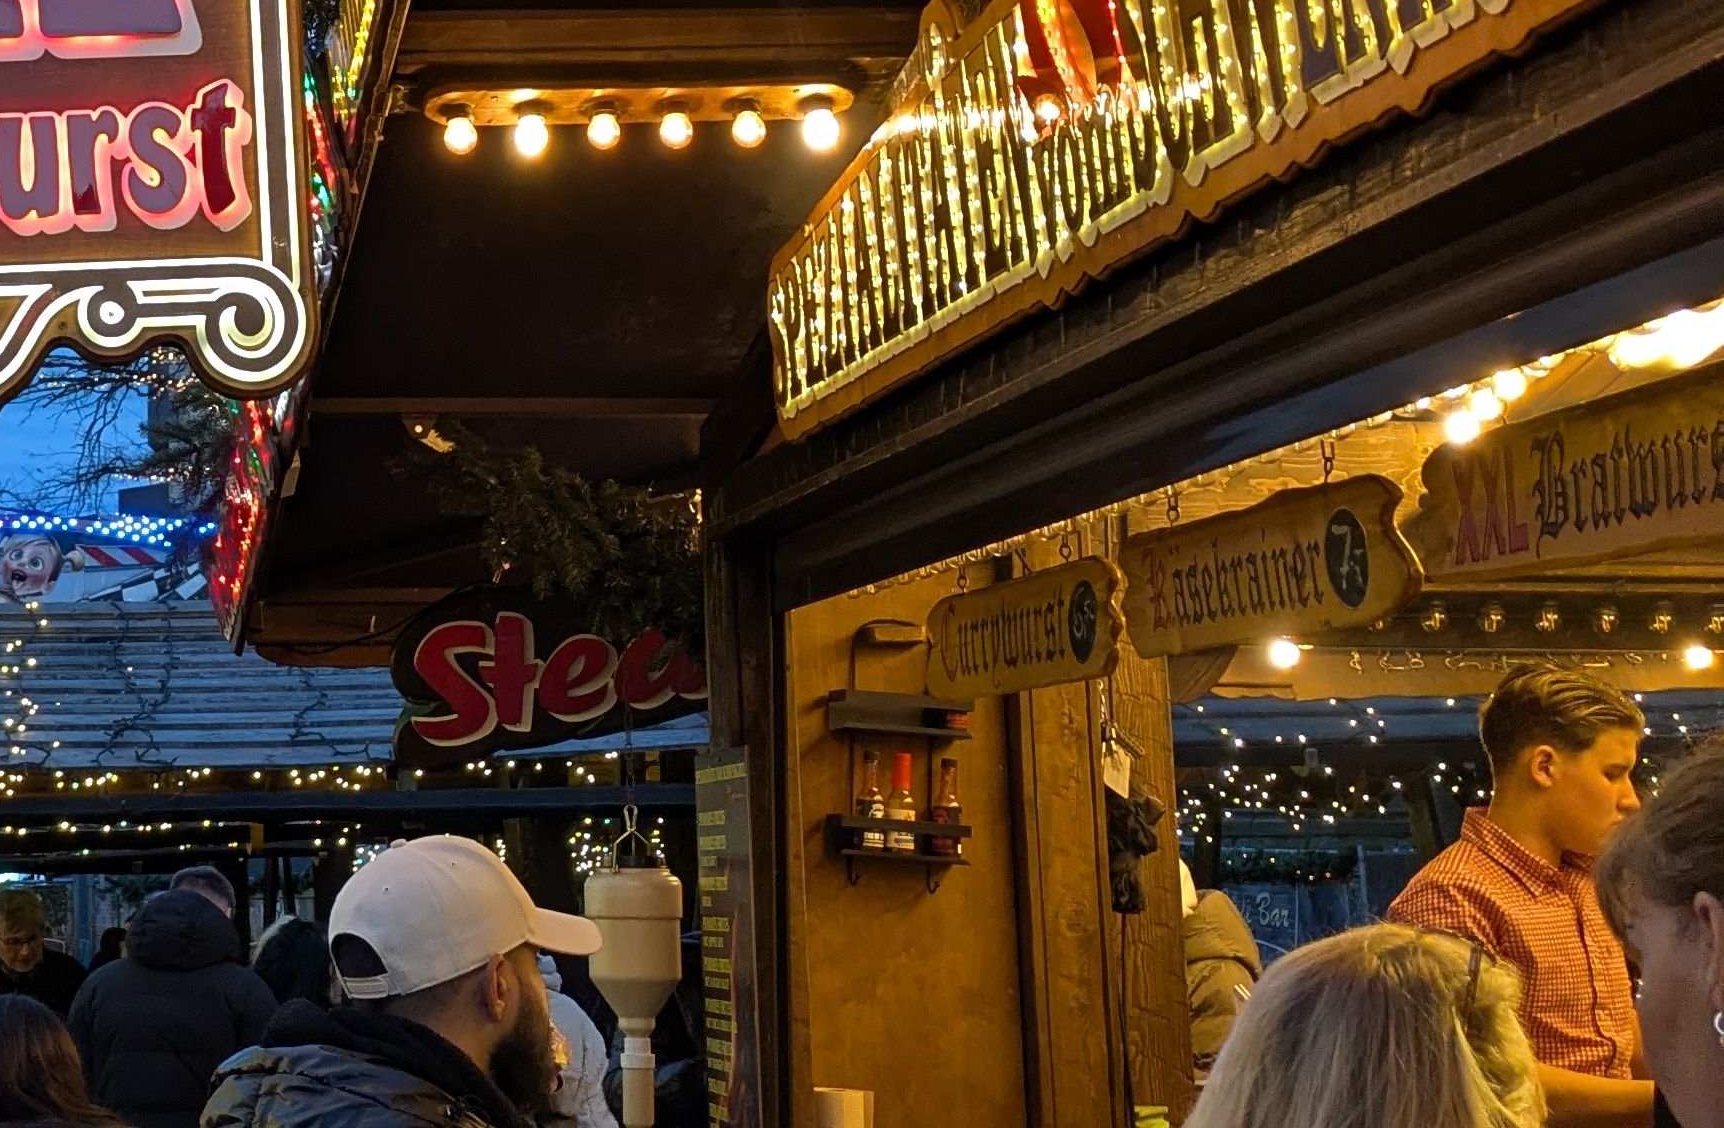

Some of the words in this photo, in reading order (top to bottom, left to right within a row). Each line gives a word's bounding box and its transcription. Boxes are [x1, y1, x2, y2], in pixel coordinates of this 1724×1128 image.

[1451, 442, 1529, 565] XXL
[941, 583, 1066, 689] Currywurst
[1256, 891, 1289, 928] Bar
